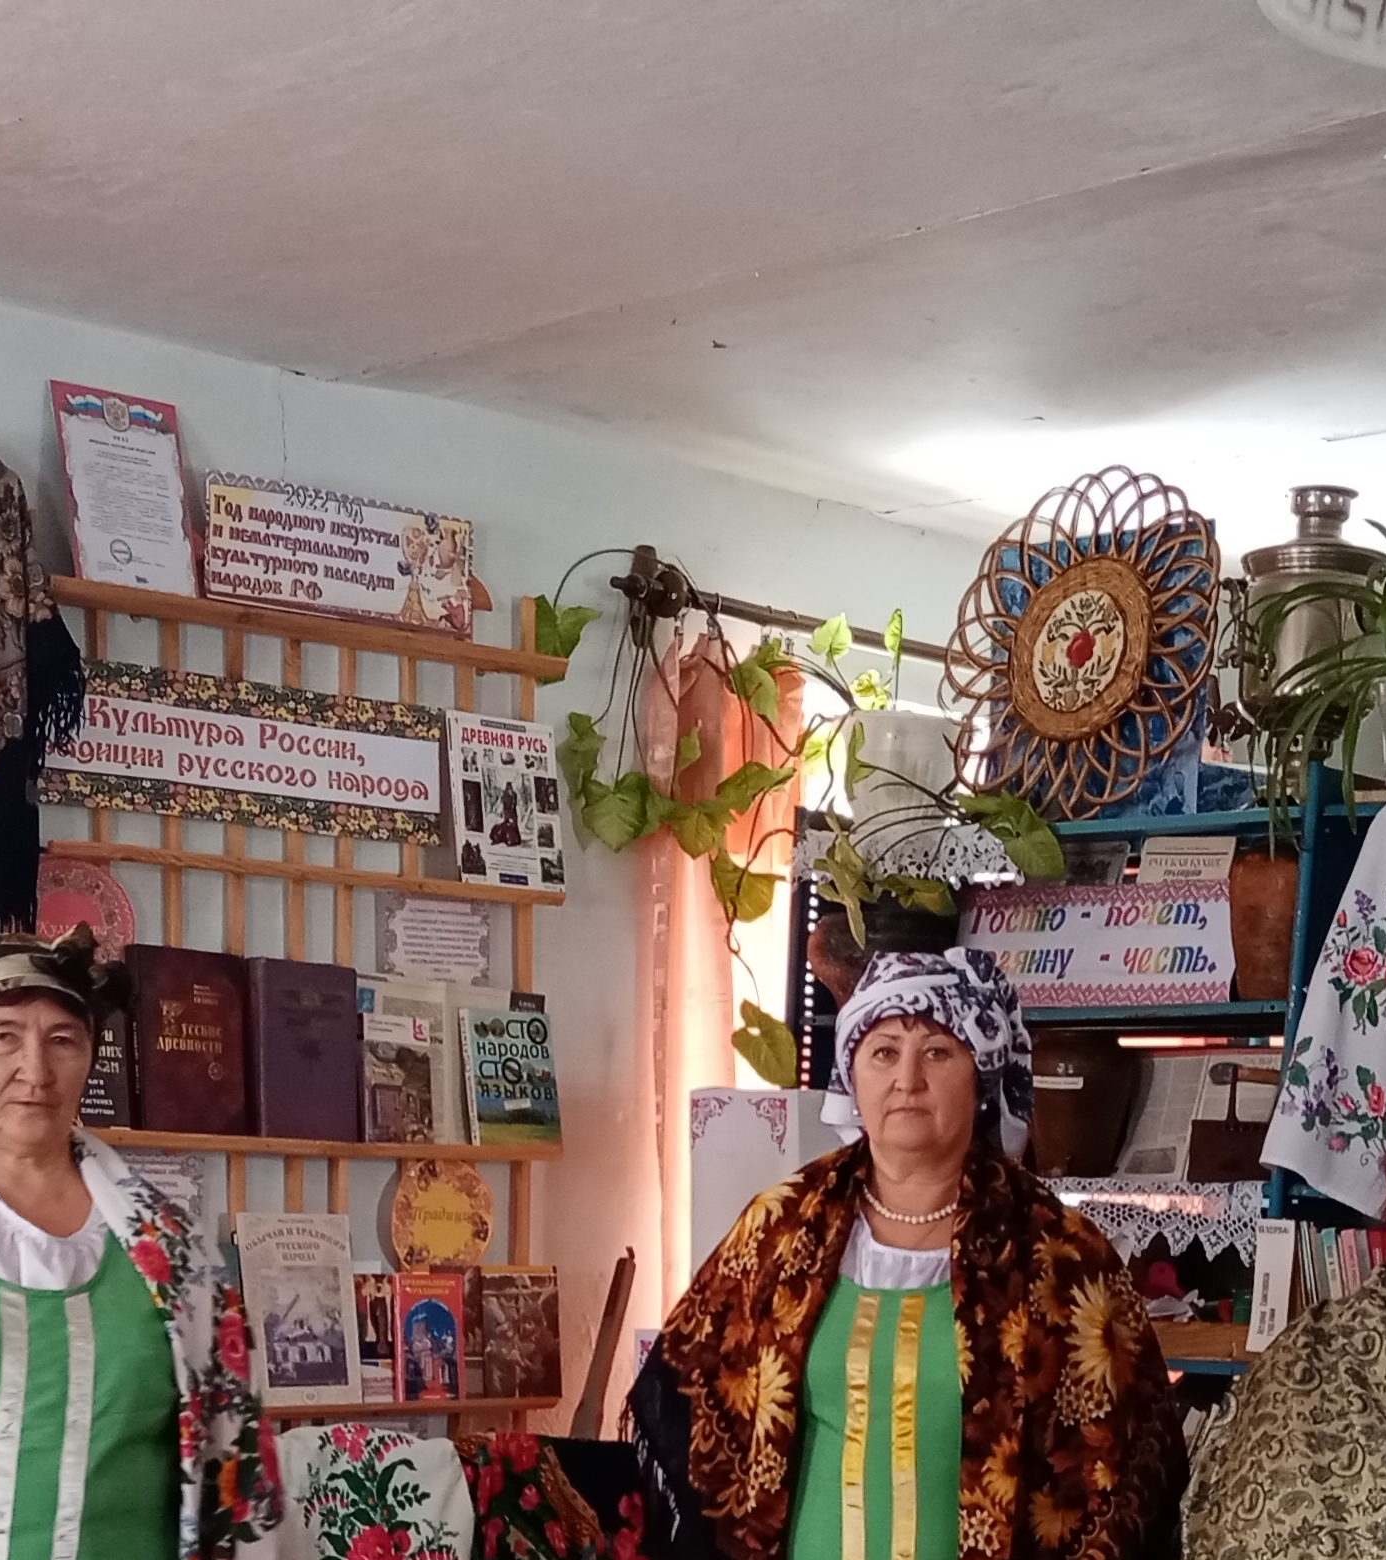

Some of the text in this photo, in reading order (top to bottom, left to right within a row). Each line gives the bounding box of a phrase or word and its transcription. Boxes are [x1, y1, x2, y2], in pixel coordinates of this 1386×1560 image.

[213, 494, 400, 548] Год народного искусства
[213, 523, 370, 565] и нематериального
[211, 545, 395, 592] культурного наследия
[211, 571, 324, 601] народов РФ
[87, 697, 367, 767] Культура России,
[461, 727, 548, 754] ДРЕВНЯЯ РУСЬ
[177, 751, 317, 789] русского
[327, 770, 430, 802] народа
[971, 903, 1067, 935] Гостю
[1104, 901, 1208, 930] почет,
[997, 947, 1075, 980] зяину
[1123, 945, 1218, 975] честь.
[156, 1035, 223, 1055] Древности
[505, 1016, 548, 1046] СТО
[476, 1040, 550, 1060] народов
[478, 1057, 524, 1085] СТО
[275, 1242, 320, 1250] РУССКОГО
[282, 1252, 316, 1261] НАРОДА
